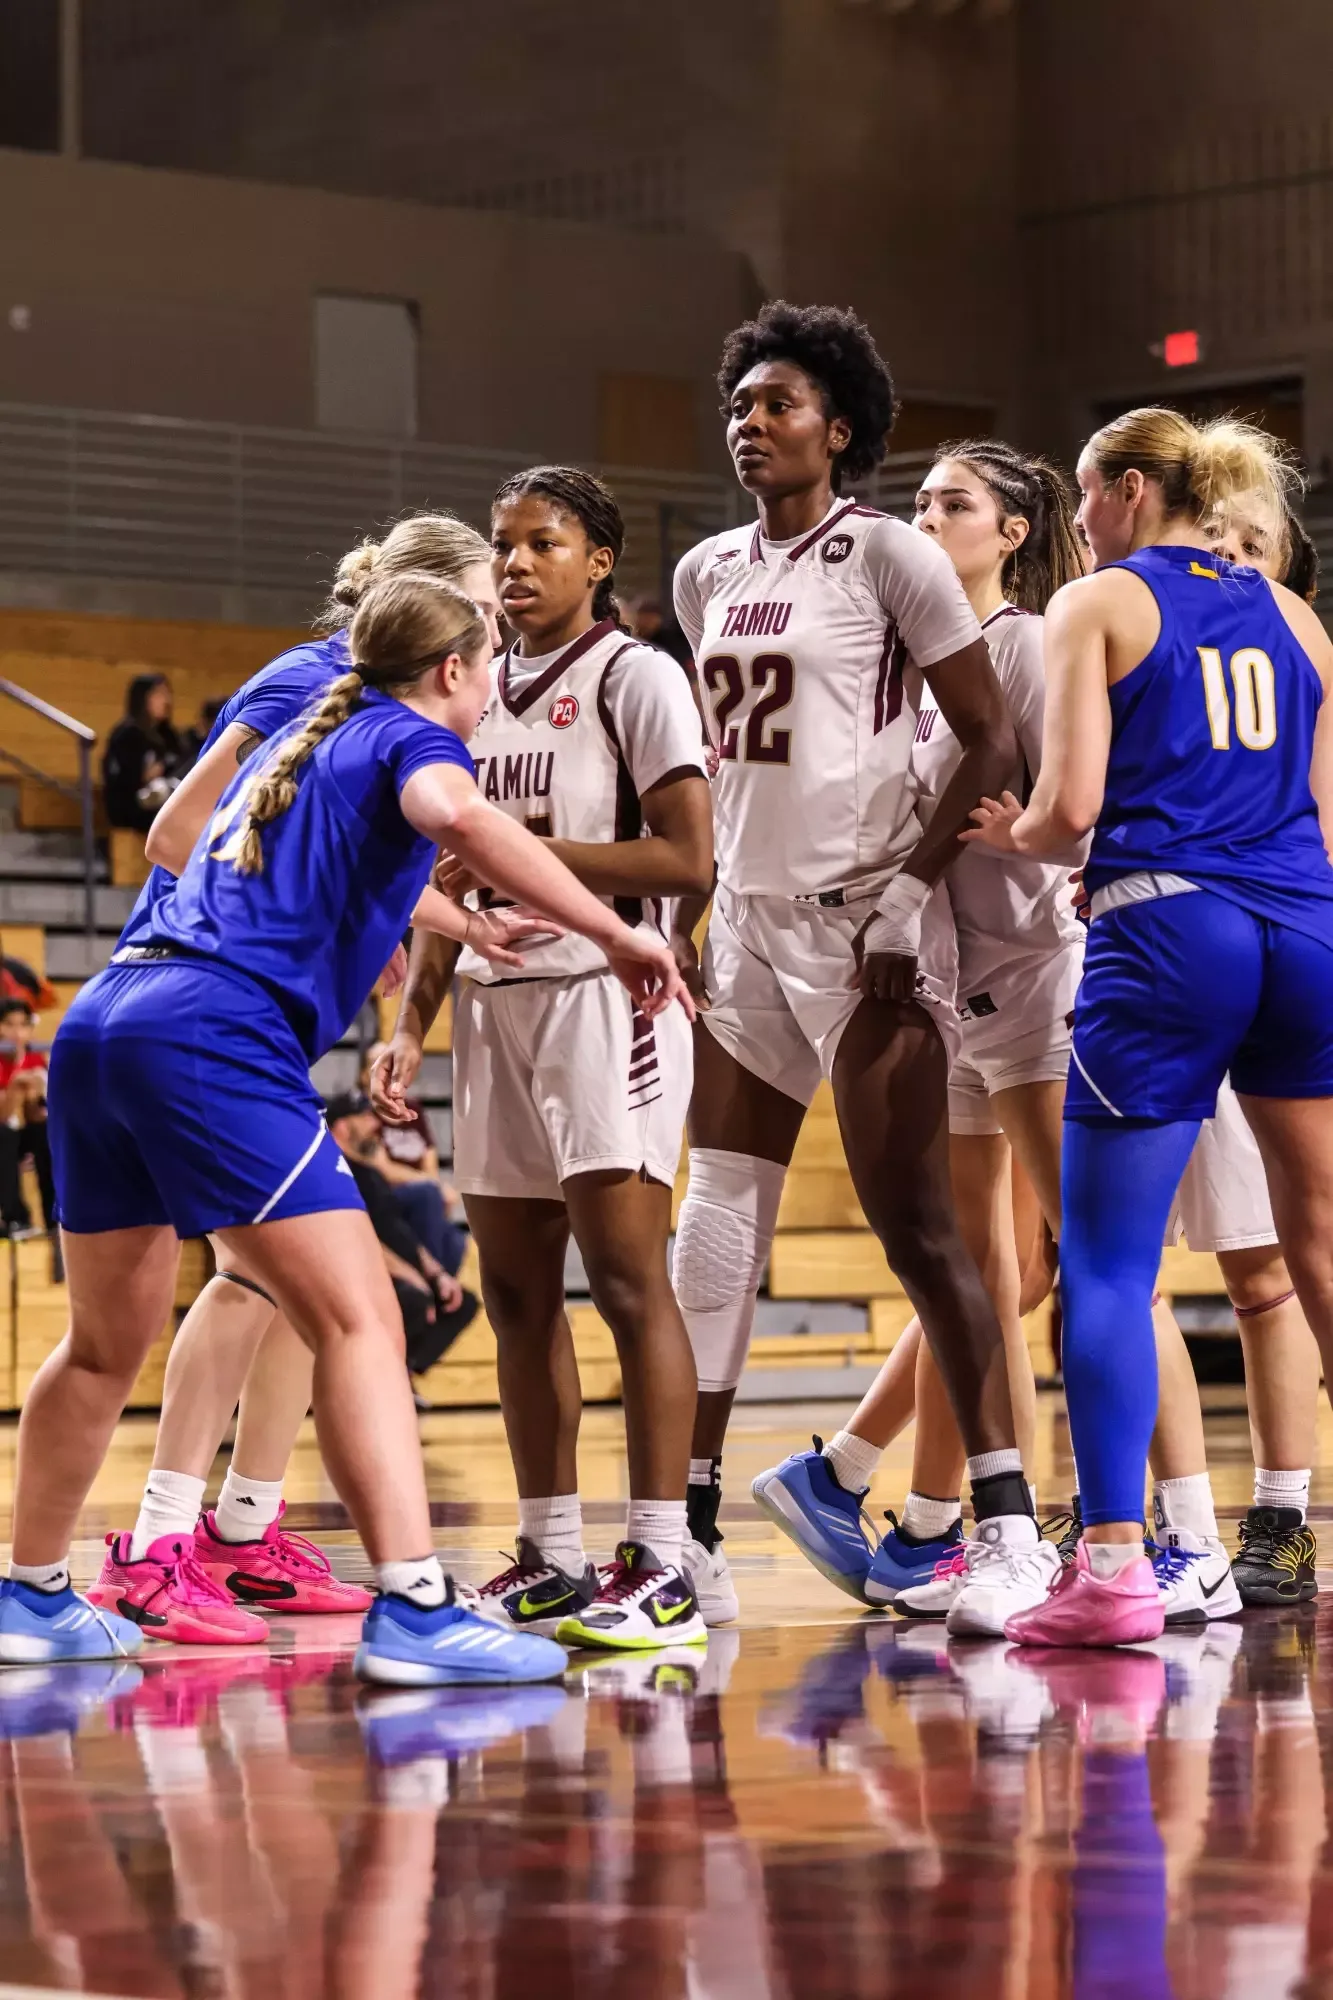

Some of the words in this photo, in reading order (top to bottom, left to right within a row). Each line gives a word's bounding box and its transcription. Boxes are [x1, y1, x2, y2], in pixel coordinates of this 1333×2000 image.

[826, 541, 847, 557] PA
[720, 602, 793, 638] TAMIU
[552, 702, 574, 723] PA
[703, 652, 796, 766] 22
[1195, 646, 1278, 751] 10
[474, 752, 555, 802] TAMIU
